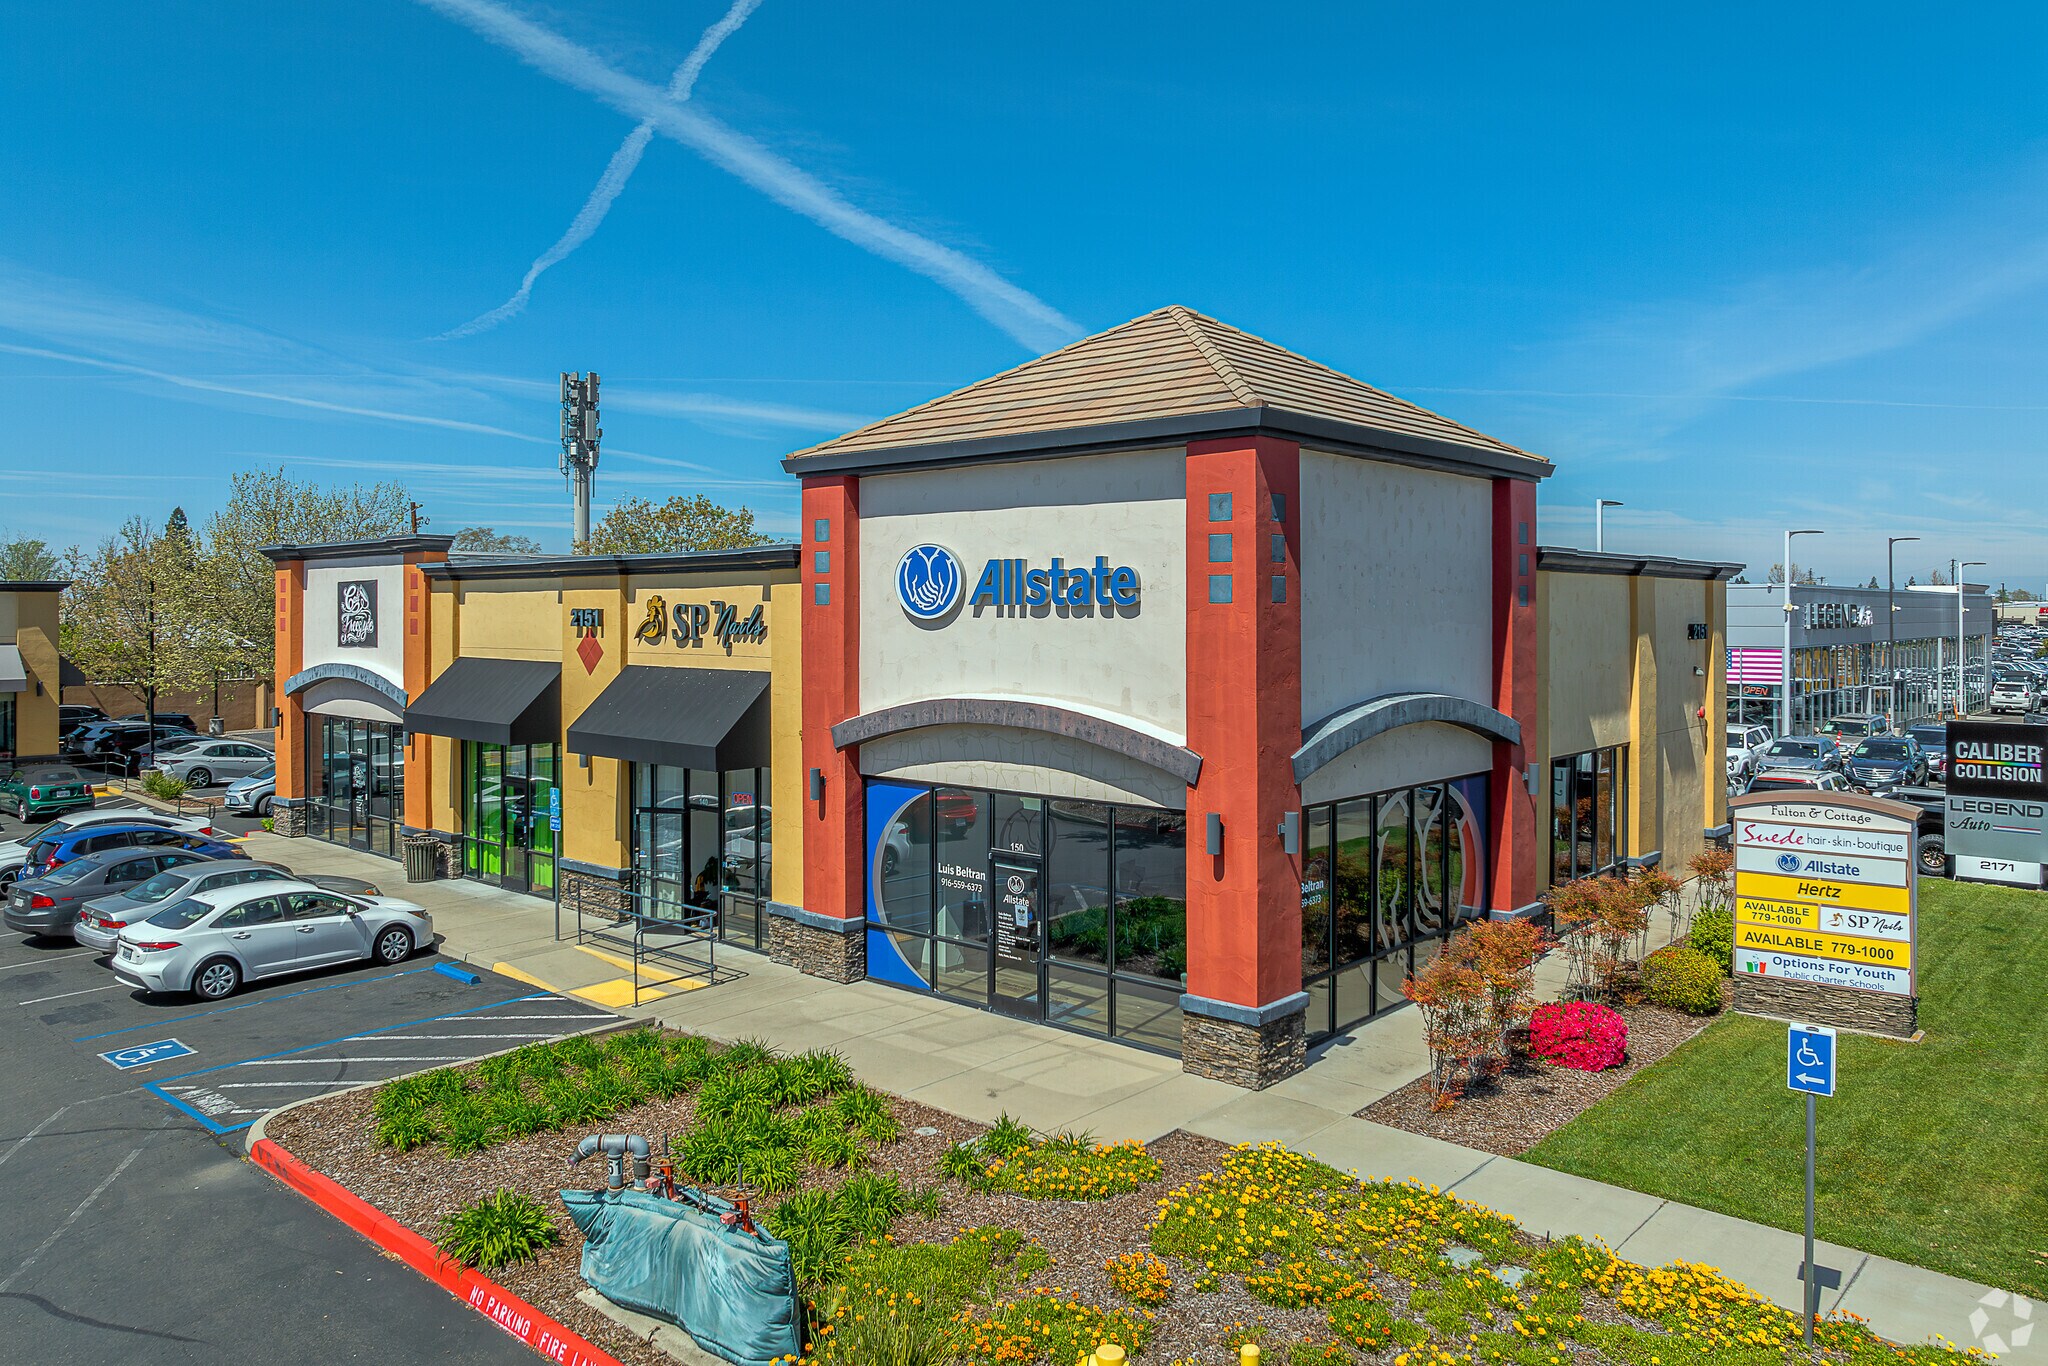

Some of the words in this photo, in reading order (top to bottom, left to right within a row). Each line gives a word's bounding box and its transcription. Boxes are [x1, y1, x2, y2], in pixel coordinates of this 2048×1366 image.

[970, 556, 1138, 606] Allstate
[570, 608, 599, 627] 2151
[673, 603, 709, 641] SP
[712, 600, 765, 648] Nails
[1743, 686, 1769, 697] OPEN
[1955, 741, 2042, 763] CALIBER
[1955, 764, 2042, 783] COLLISION
[733, 793, 754, 805] OPEN
[1950, 799, 2044, 818] LEGEND
[1770, 804, 1806, 818] Fulton
[1809, 807, 1822, 819] &
[1824, 808, 1872, 825] Cottage
[1950, 816, 1991, 831] Auto
[1743, 823, 1805, 845] Suede
[1010, 842, 1024, 852] 150
[937, 862, 955, 877] Luis
[956, 866, 986, 881] Beltran
[1804, 860, 1860, 877] Allstate
[1980, 860, 2015, 872] 2171
[941, 877, 983, 893] 916-559-6373
[1797, 882, 1842, 898] Hertz
[1003, 894, 1029, 907] Allstate
[1743, 901, 1810, 917] AVAILABLE
[1751, 911, 1802, 926] 779-1000
[1847, 914, 1870, 929] SP
[1871, 916, 1904, 934] Nails
[1744, 931, 1824, 951] AVAILABLE
[1831, 941, 1894, 960] 779-1000
[1772, 956, 1825, 972] Options
[1828, 963, 1851, 976] For
[1853, 967, 1896, 981] Youth
[1784, 970, 1810, 981] Public
[1812, 974, 1847, 987] Charter
[1849, 979, 1885, 991] Schools
[469, 1284, 485, 1308] NO
[485, 1296, 531, 1337] PARKING
[539, 1330, 568, 1362] FIRE
